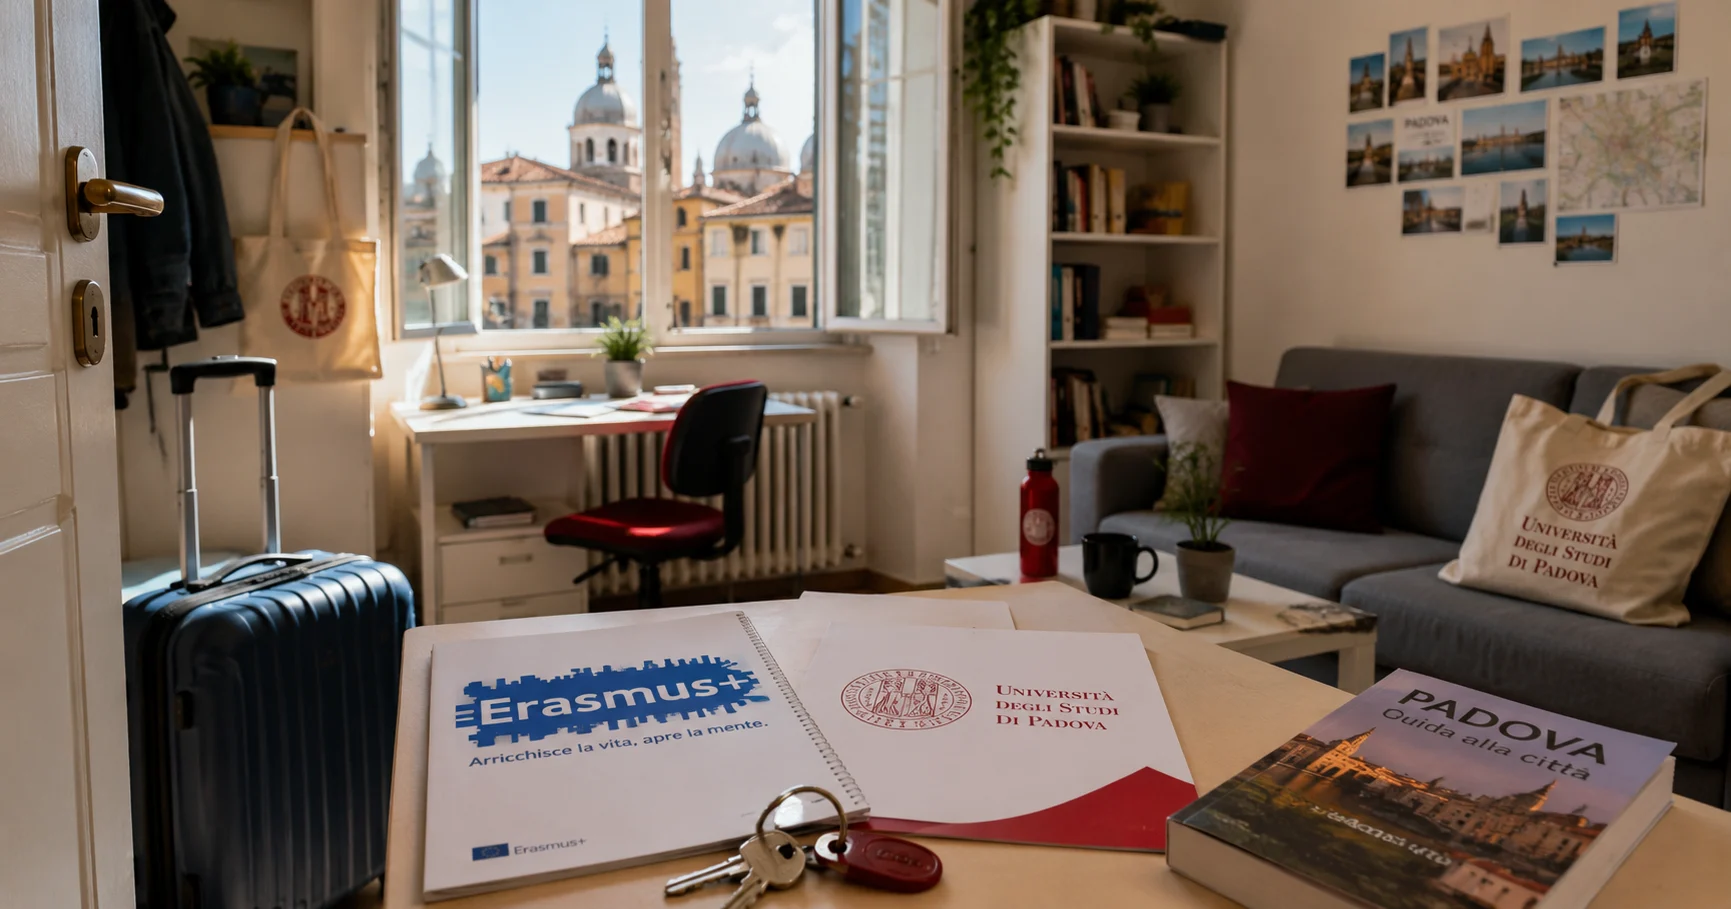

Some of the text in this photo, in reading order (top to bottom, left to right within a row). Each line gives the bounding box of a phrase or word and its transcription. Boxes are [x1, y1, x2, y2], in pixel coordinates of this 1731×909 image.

[1404, 115, 1449, 128] PADOVA
[480, 674, 749, 725] Erasmus+
[469, 719, 768, 767] Arricchisce la vita, apre la mente.
[1398, 689, 1606, 765] PADOVA
[1462, 735, 1512, 756] alla
[1520, 754, 1591, 781] città
[514, 838, 587, 855] Erasmus+
